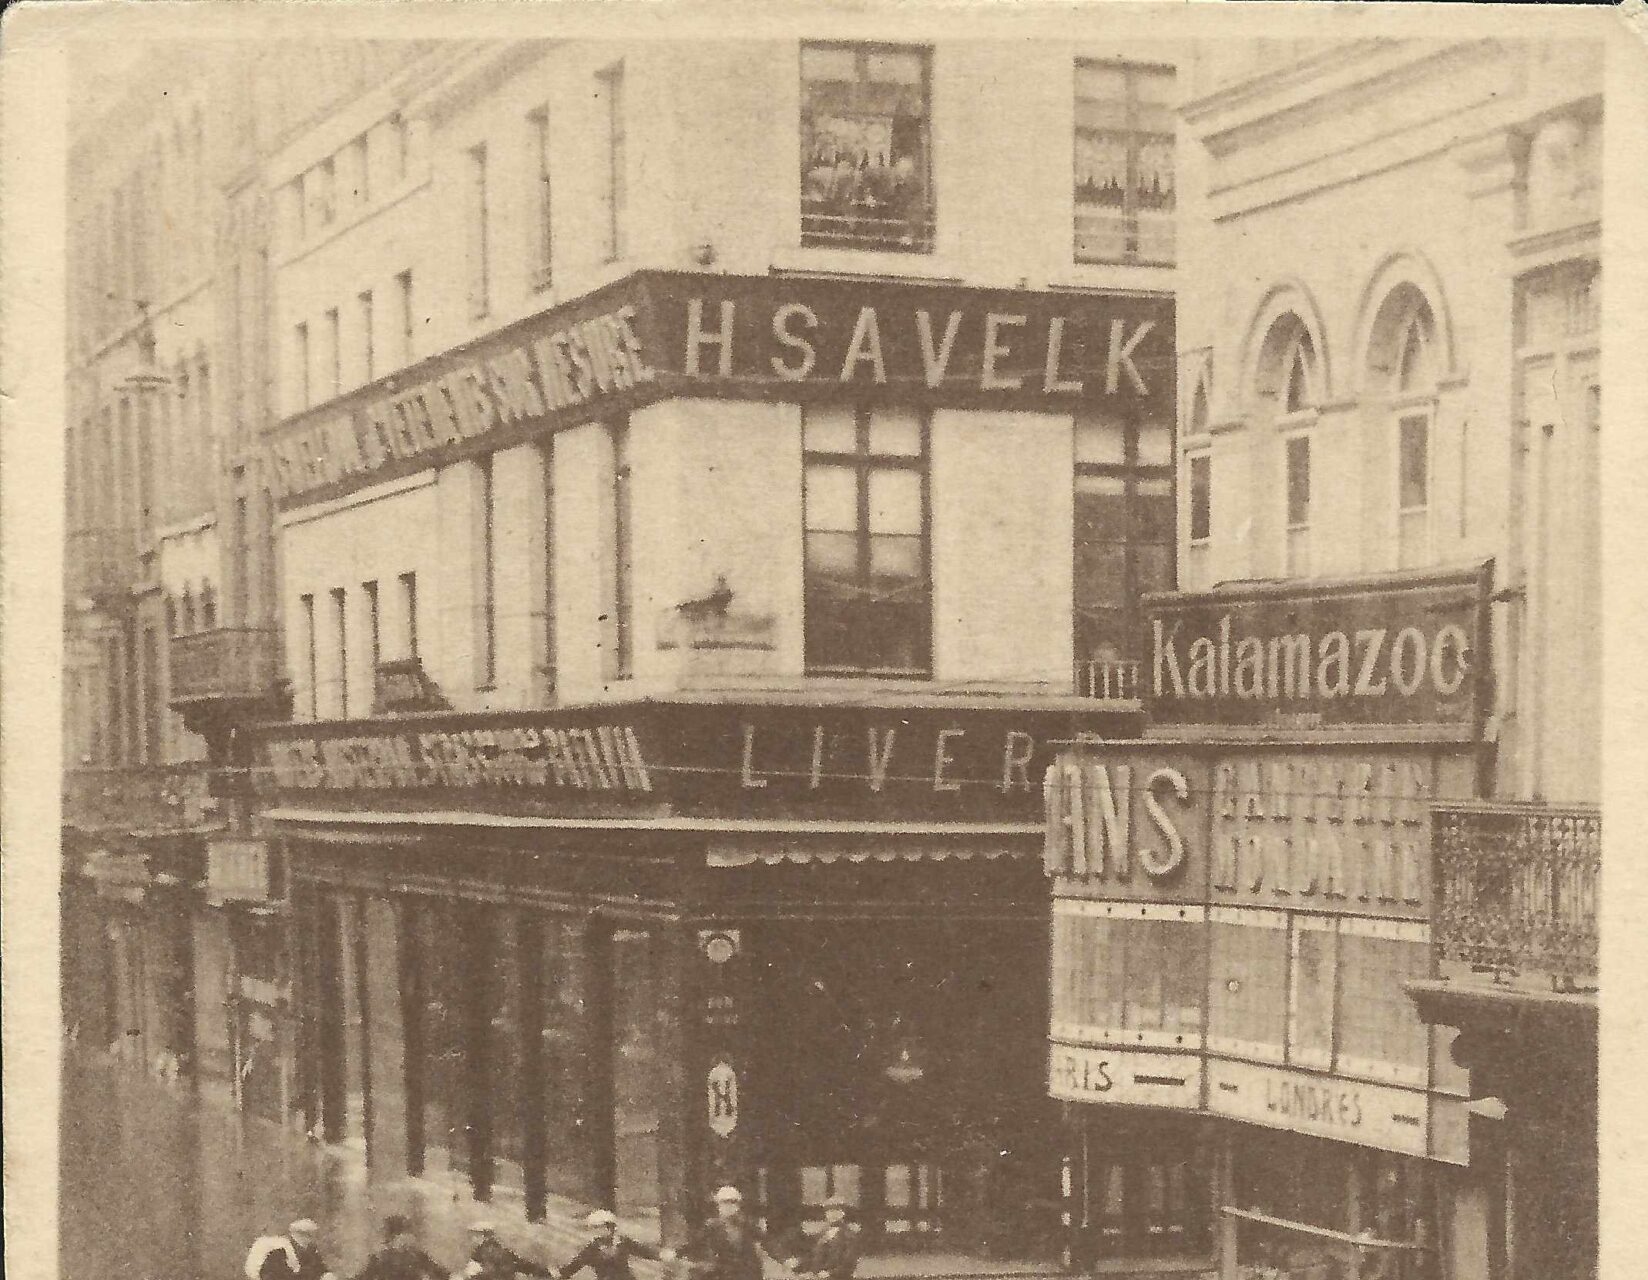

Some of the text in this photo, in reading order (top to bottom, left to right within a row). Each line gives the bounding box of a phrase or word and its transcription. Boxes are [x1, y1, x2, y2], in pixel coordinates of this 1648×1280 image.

[1152, 615, 1473, 698] Kalamazoo
[740, 725, 1100, 794] LIVER
[1265, 1076, 1363, 1128] LONDRES
